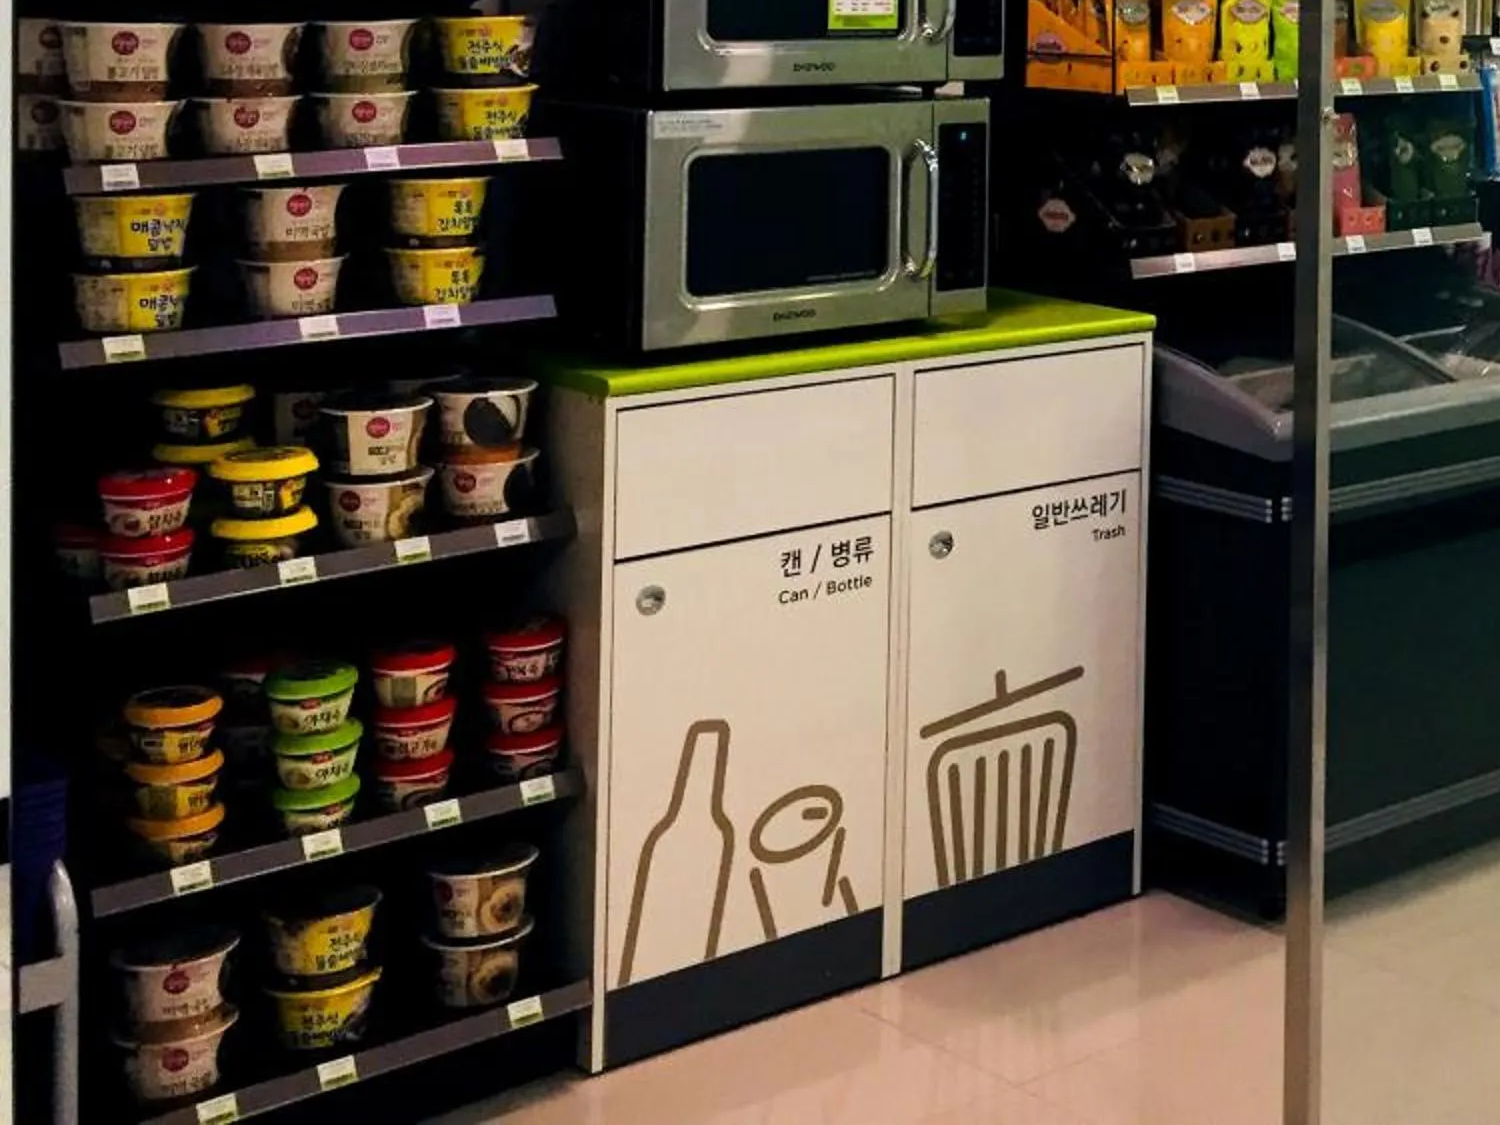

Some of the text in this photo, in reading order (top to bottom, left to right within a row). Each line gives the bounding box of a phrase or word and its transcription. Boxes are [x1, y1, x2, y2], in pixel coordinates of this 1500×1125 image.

[1031, 488, 1127, 530] 일반쓰레기
[1092, 524, 1126, 543] Trash
[780, 549, 802, 578] 캔
[831, 535, 875, 569] 병류
[778, 586, 809, 606] Can
[826, 574, 873, 597] Bottle
